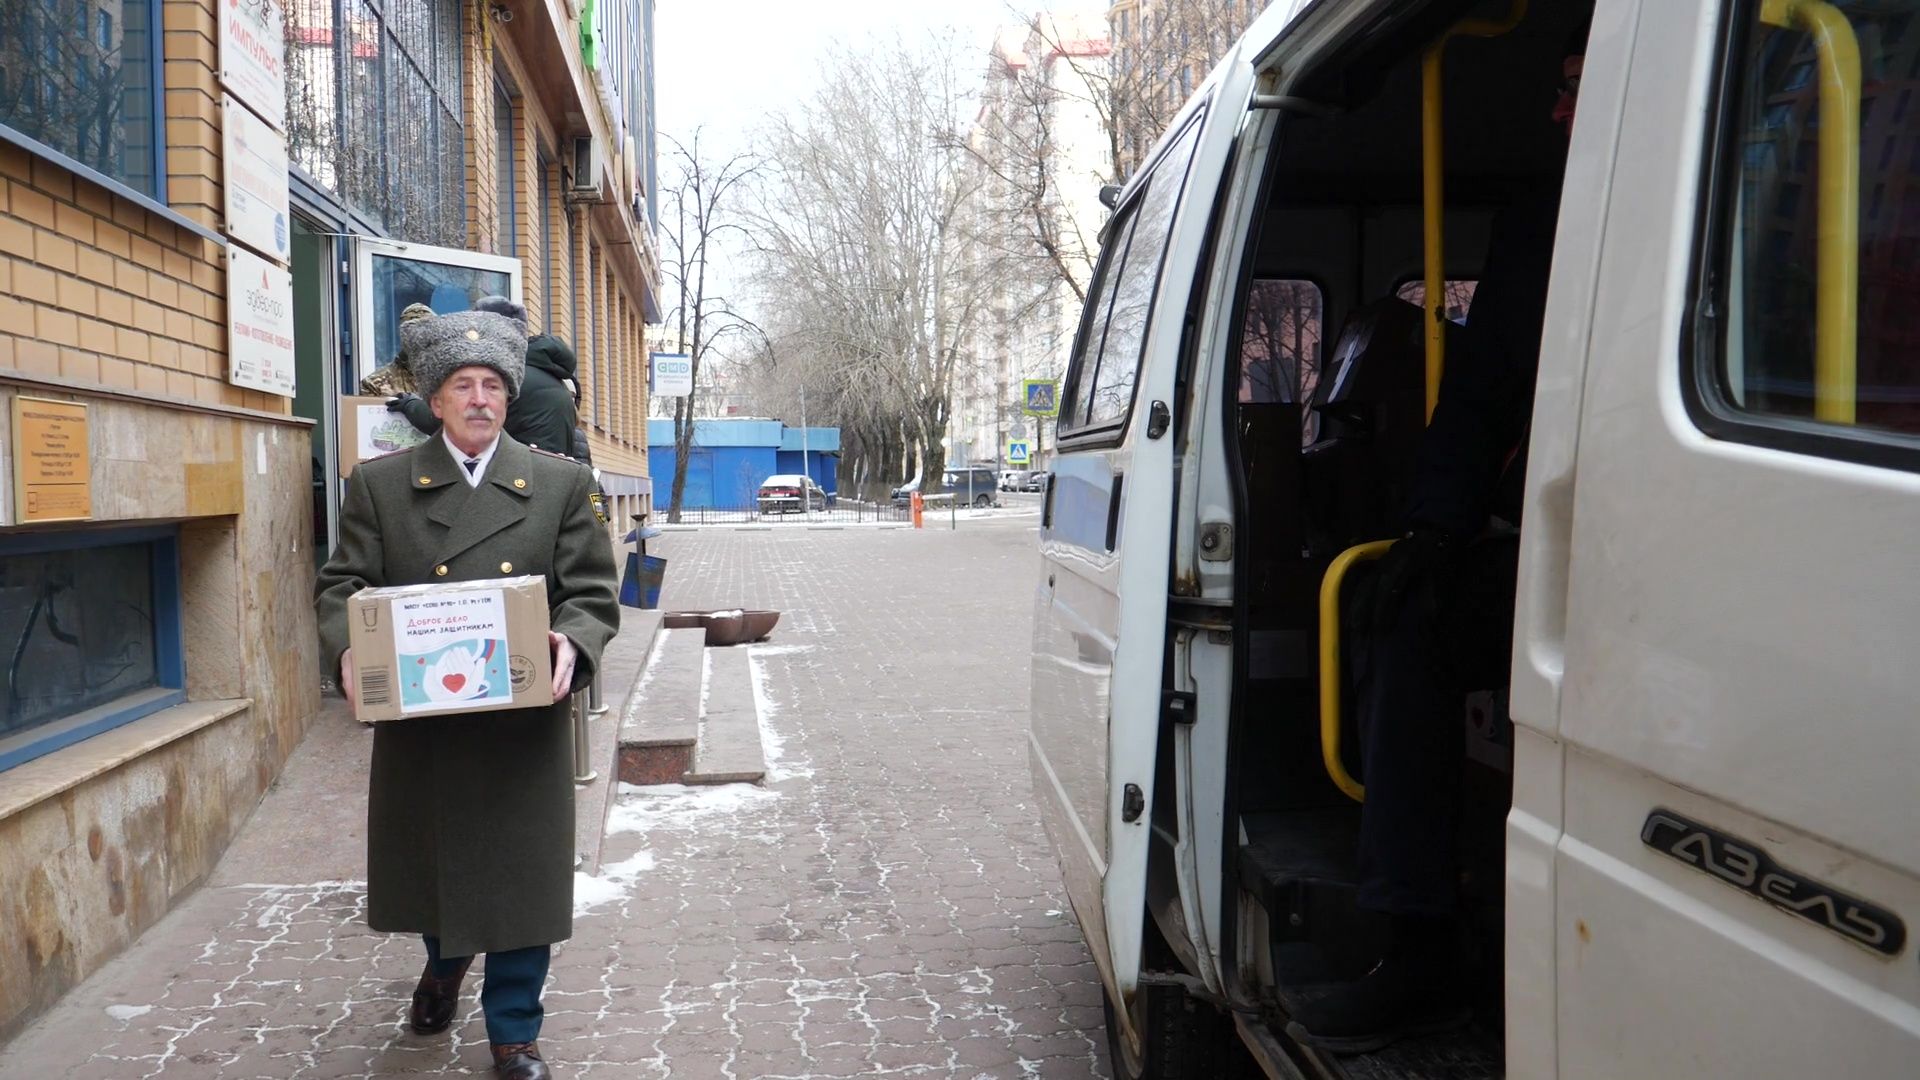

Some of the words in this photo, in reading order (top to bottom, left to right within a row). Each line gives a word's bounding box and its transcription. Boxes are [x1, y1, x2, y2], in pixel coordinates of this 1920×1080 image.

[229, 15, 278, 77] ИМПУЛЬС
[407, 628, 436, 636] НАШИМ
[440, 623, 493, 633] ЗАЩИТНИКАМ
